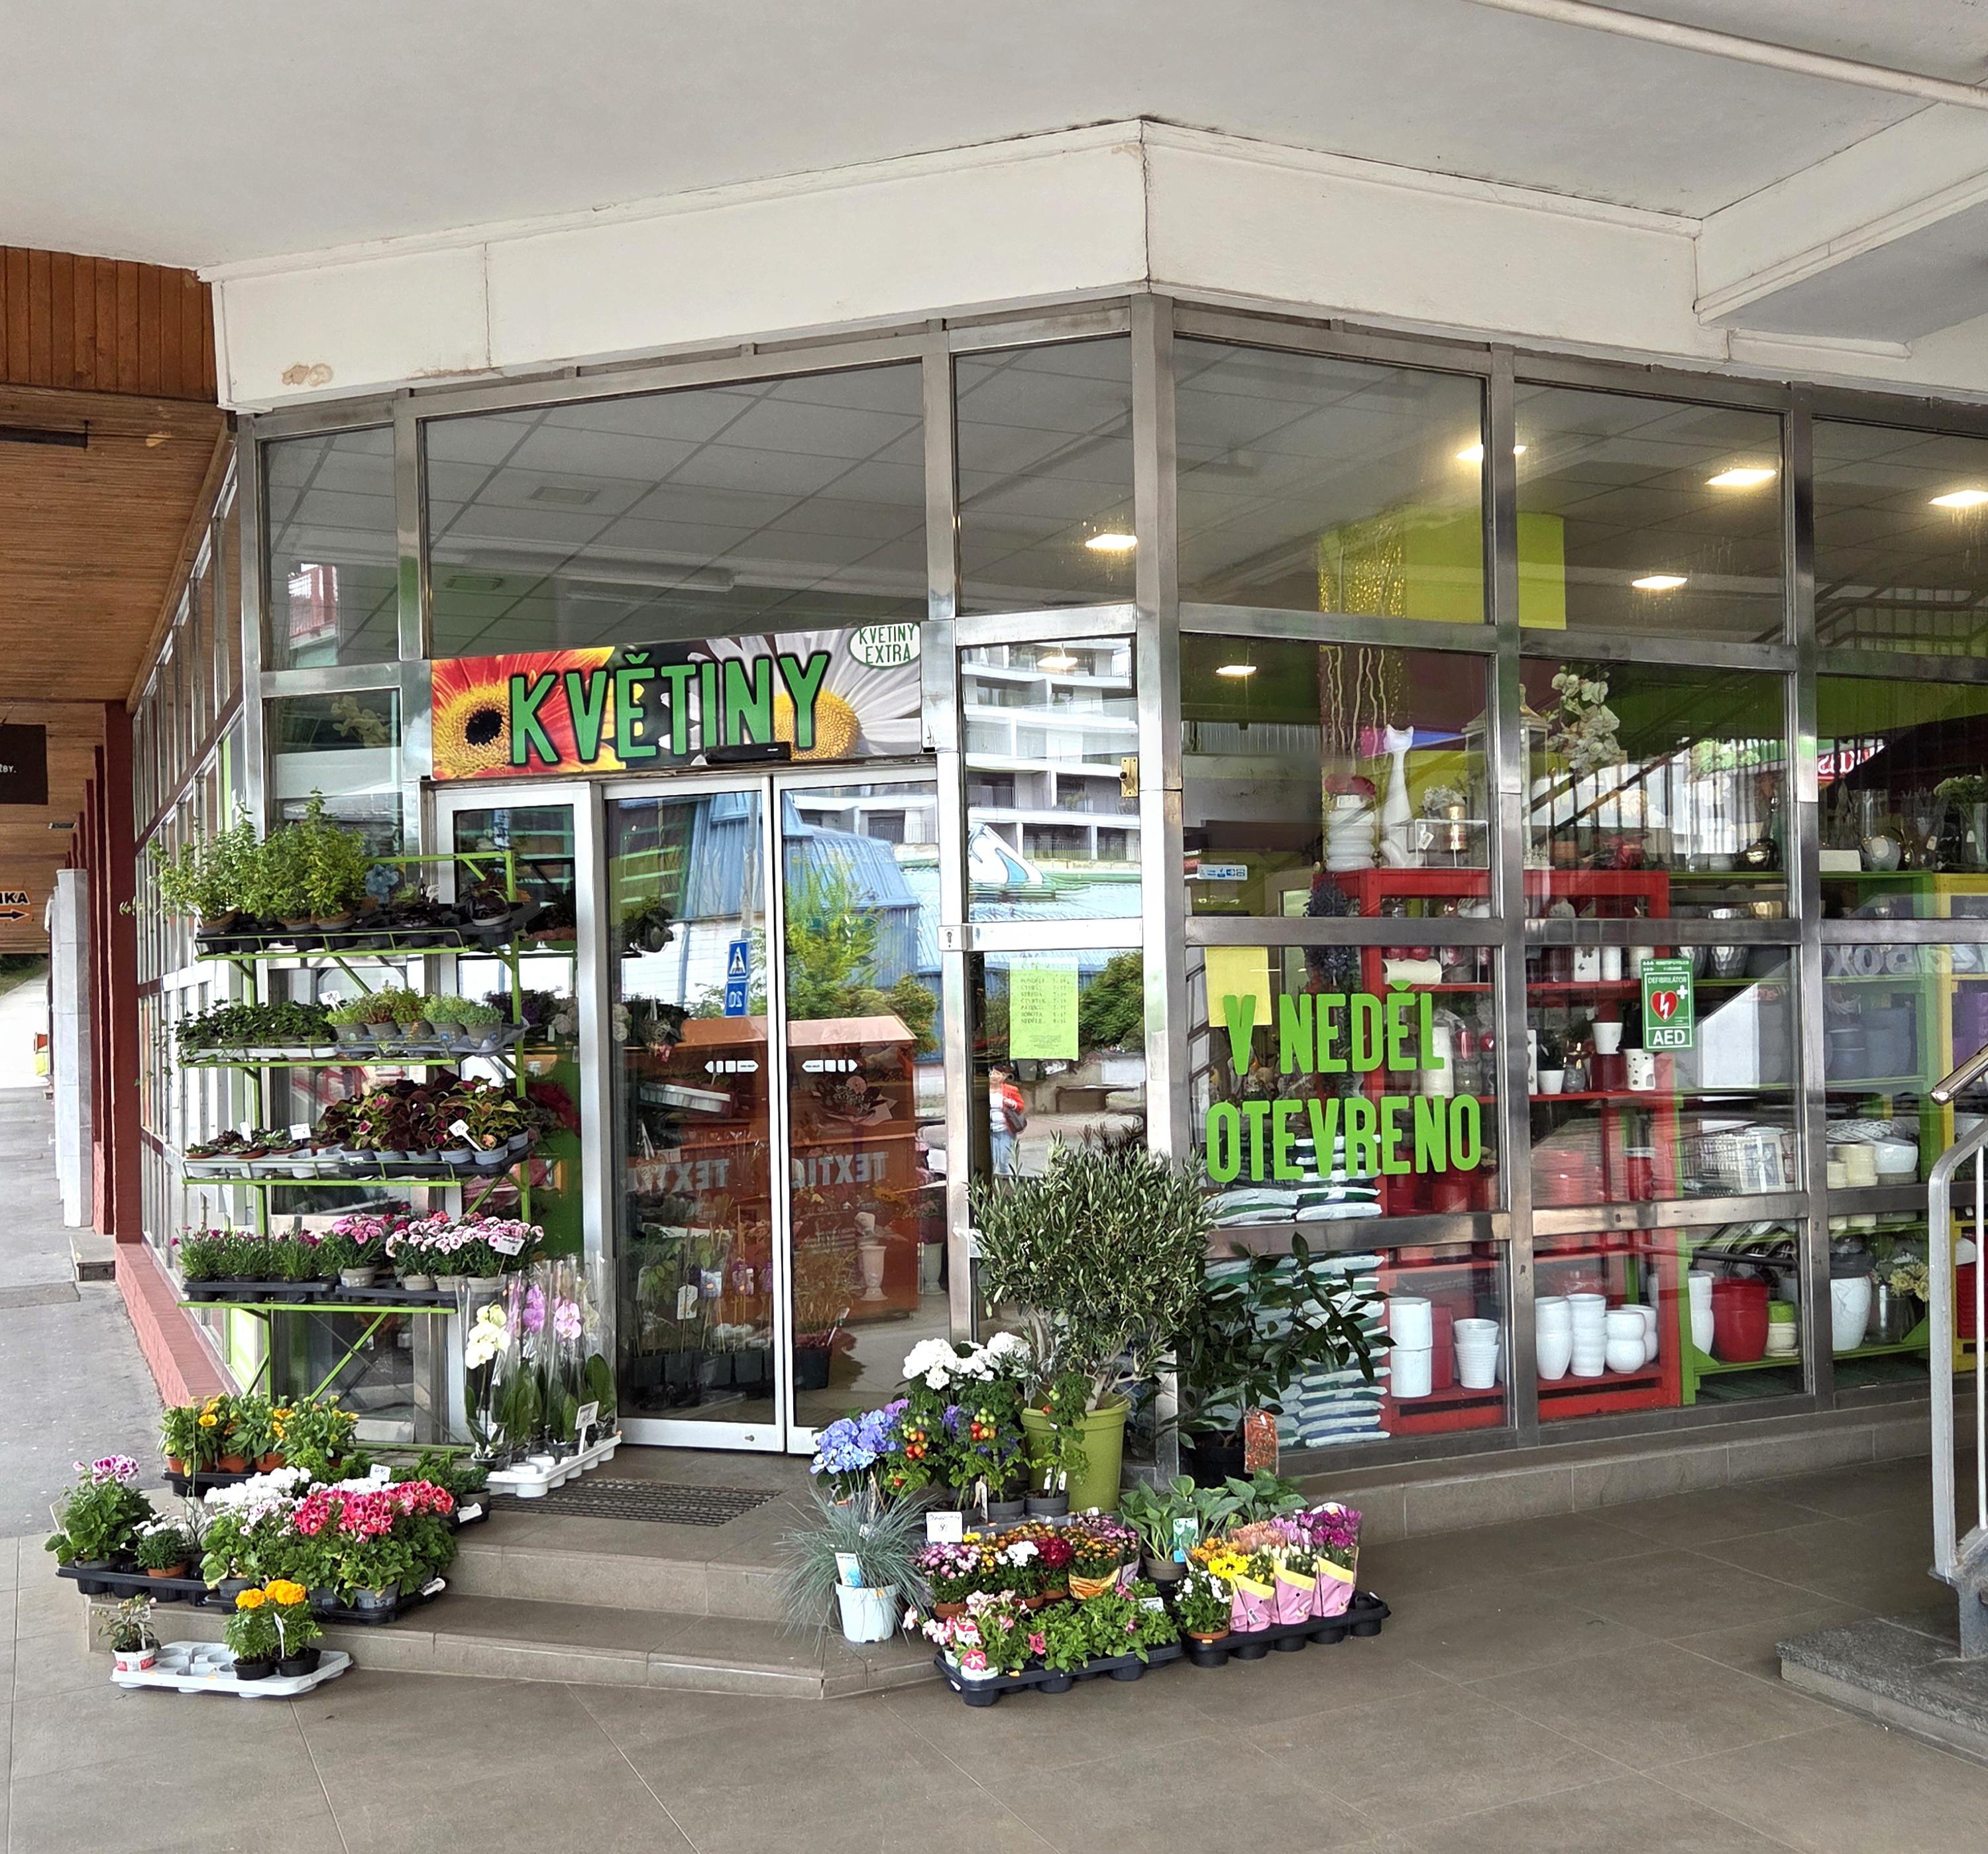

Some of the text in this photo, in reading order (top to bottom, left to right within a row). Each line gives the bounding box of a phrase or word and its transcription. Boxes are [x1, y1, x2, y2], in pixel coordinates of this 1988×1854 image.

[865, 643, 911, 663] EXTRA
[511, 653, 828, 764] KVĚTINY
[1223, 980, 1445, 1075] V NEDĚL
[1653, 1029, 1686, 1045] AED
[1205, 1093, 1481, 1183] OTEVRENO
